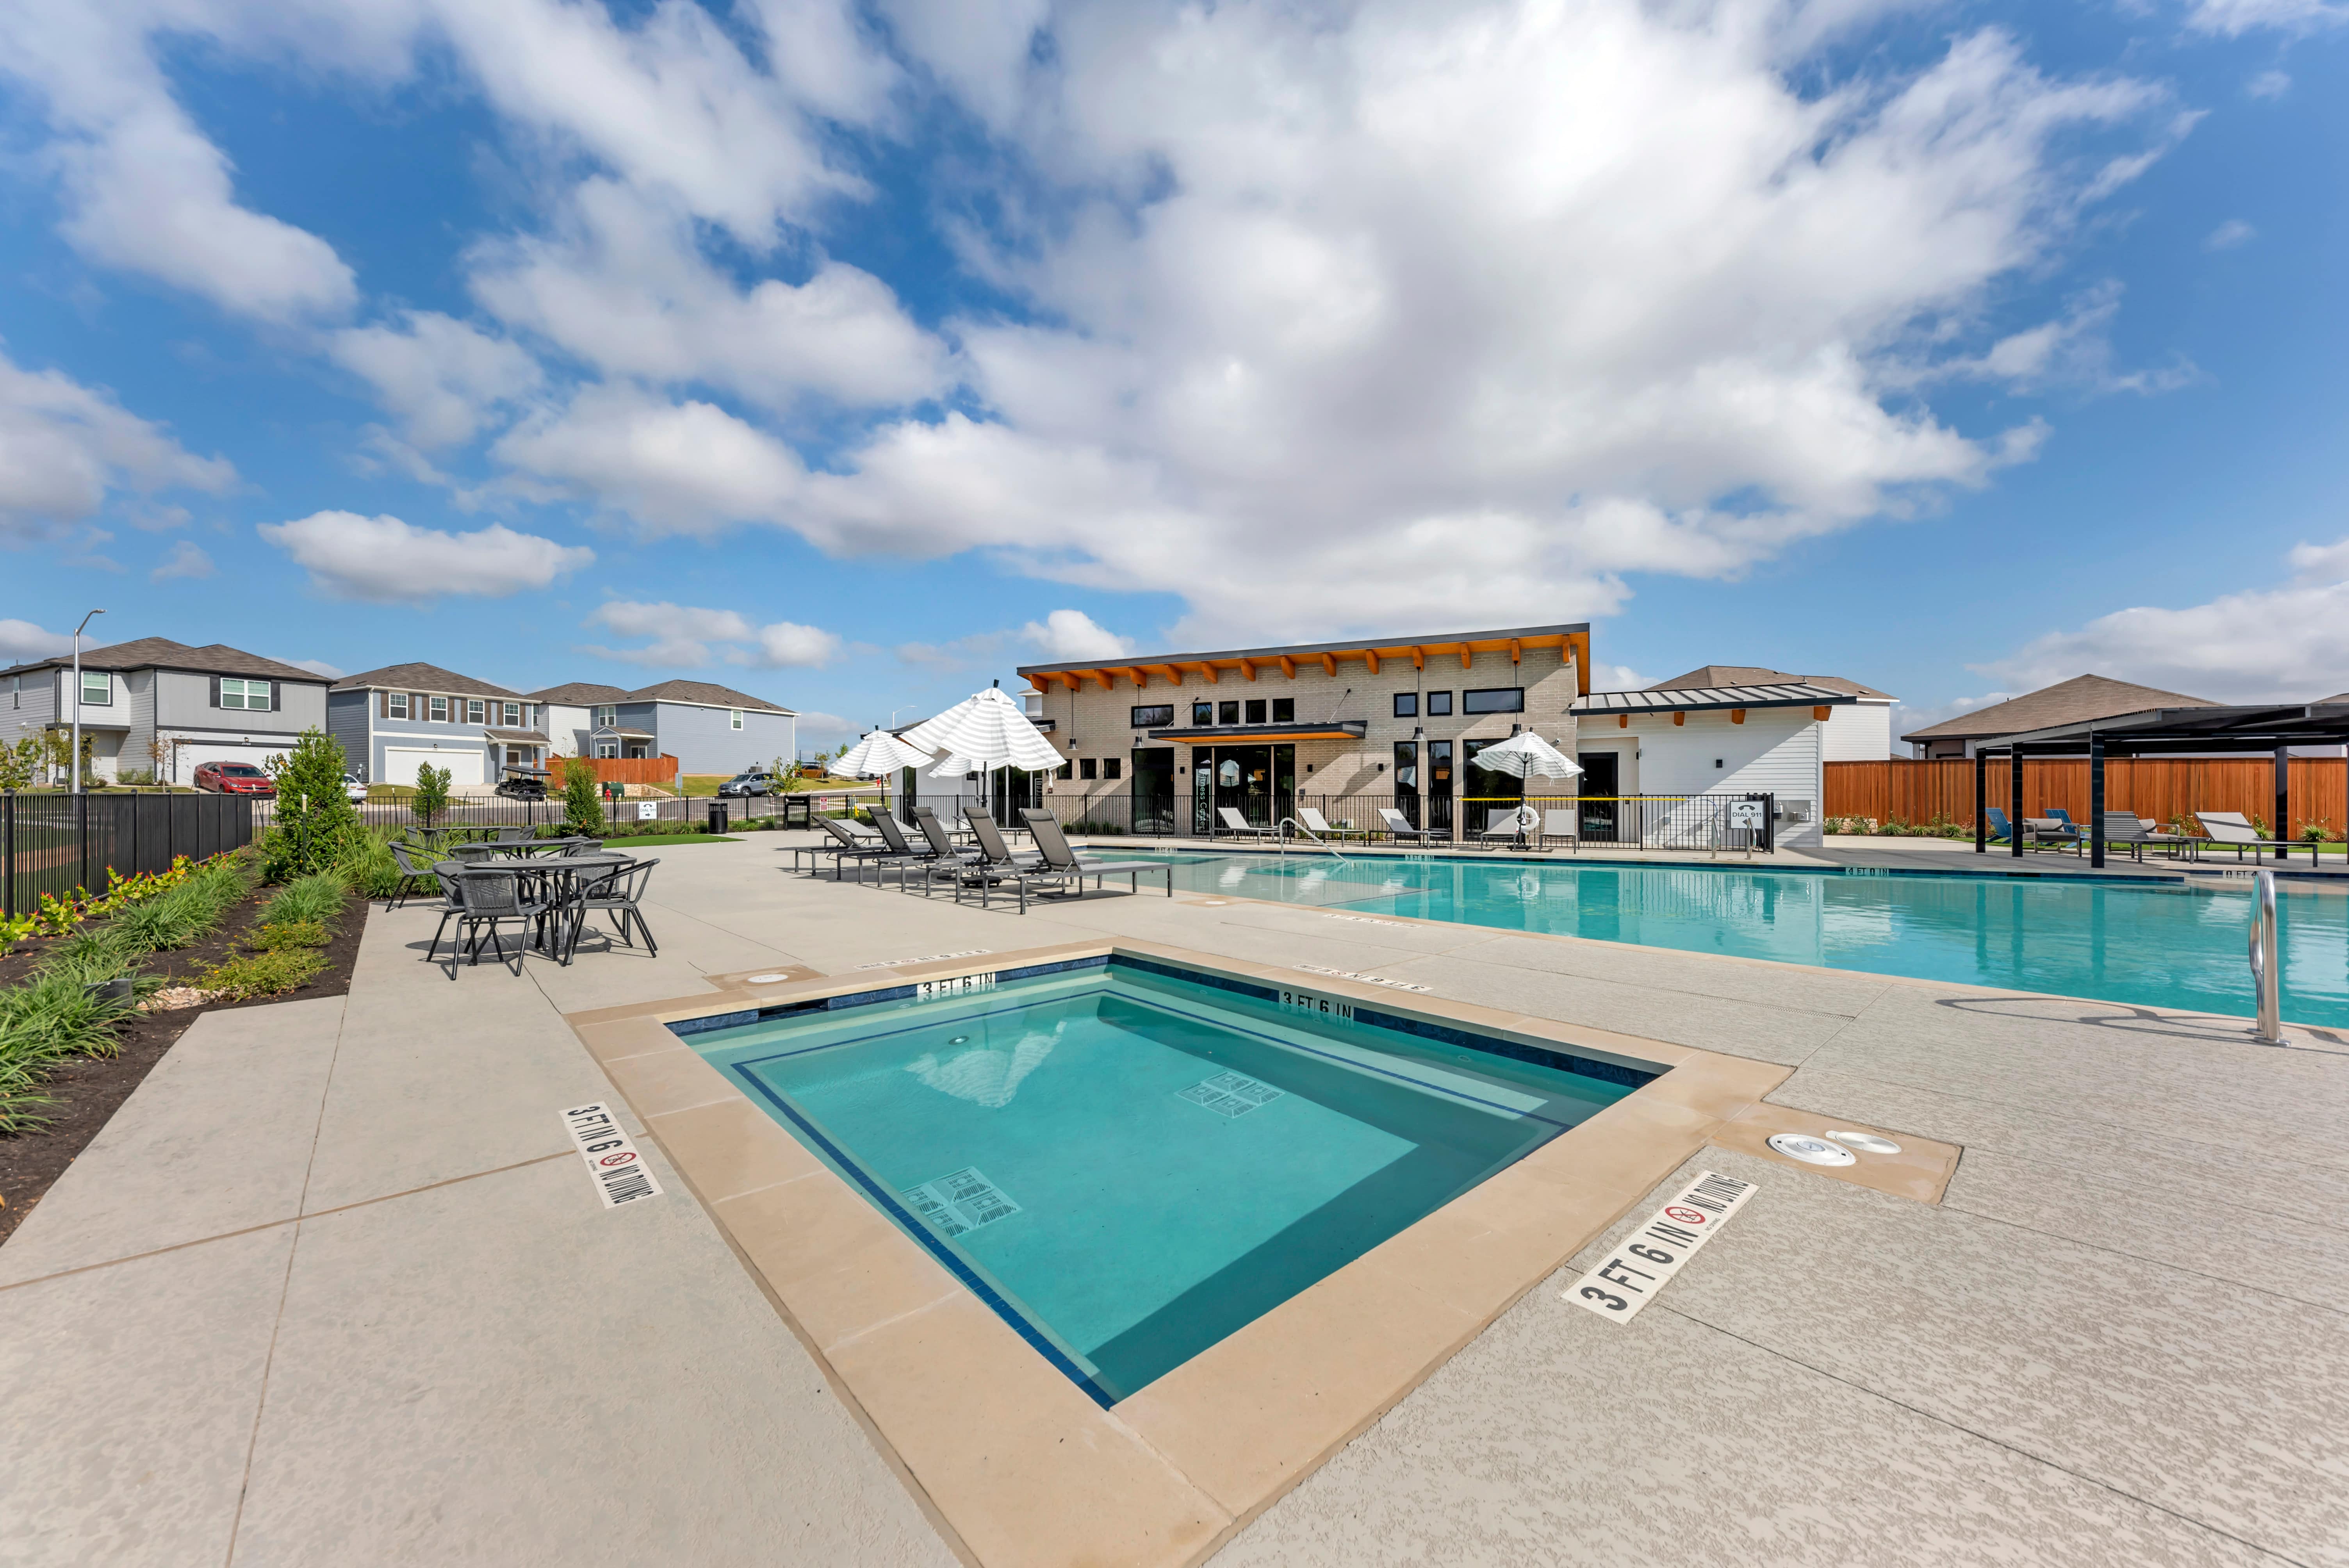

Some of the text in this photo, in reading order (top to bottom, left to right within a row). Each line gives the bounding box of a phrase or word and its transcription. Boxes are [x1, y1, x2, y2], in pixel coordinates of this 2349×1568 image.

[923, 972, 992, 993] 3 FT 6 IN
[1283, 991, 1351, 1018] 3 FT 6 IN
[567, 1106, 654, 1205] 3 FT IN 6 NO DIVING
[1709, 1218, 1721, 1227] DIVING
[1580, 1174, 1749, 1311] 3 FT 6 IN NO DIVING
